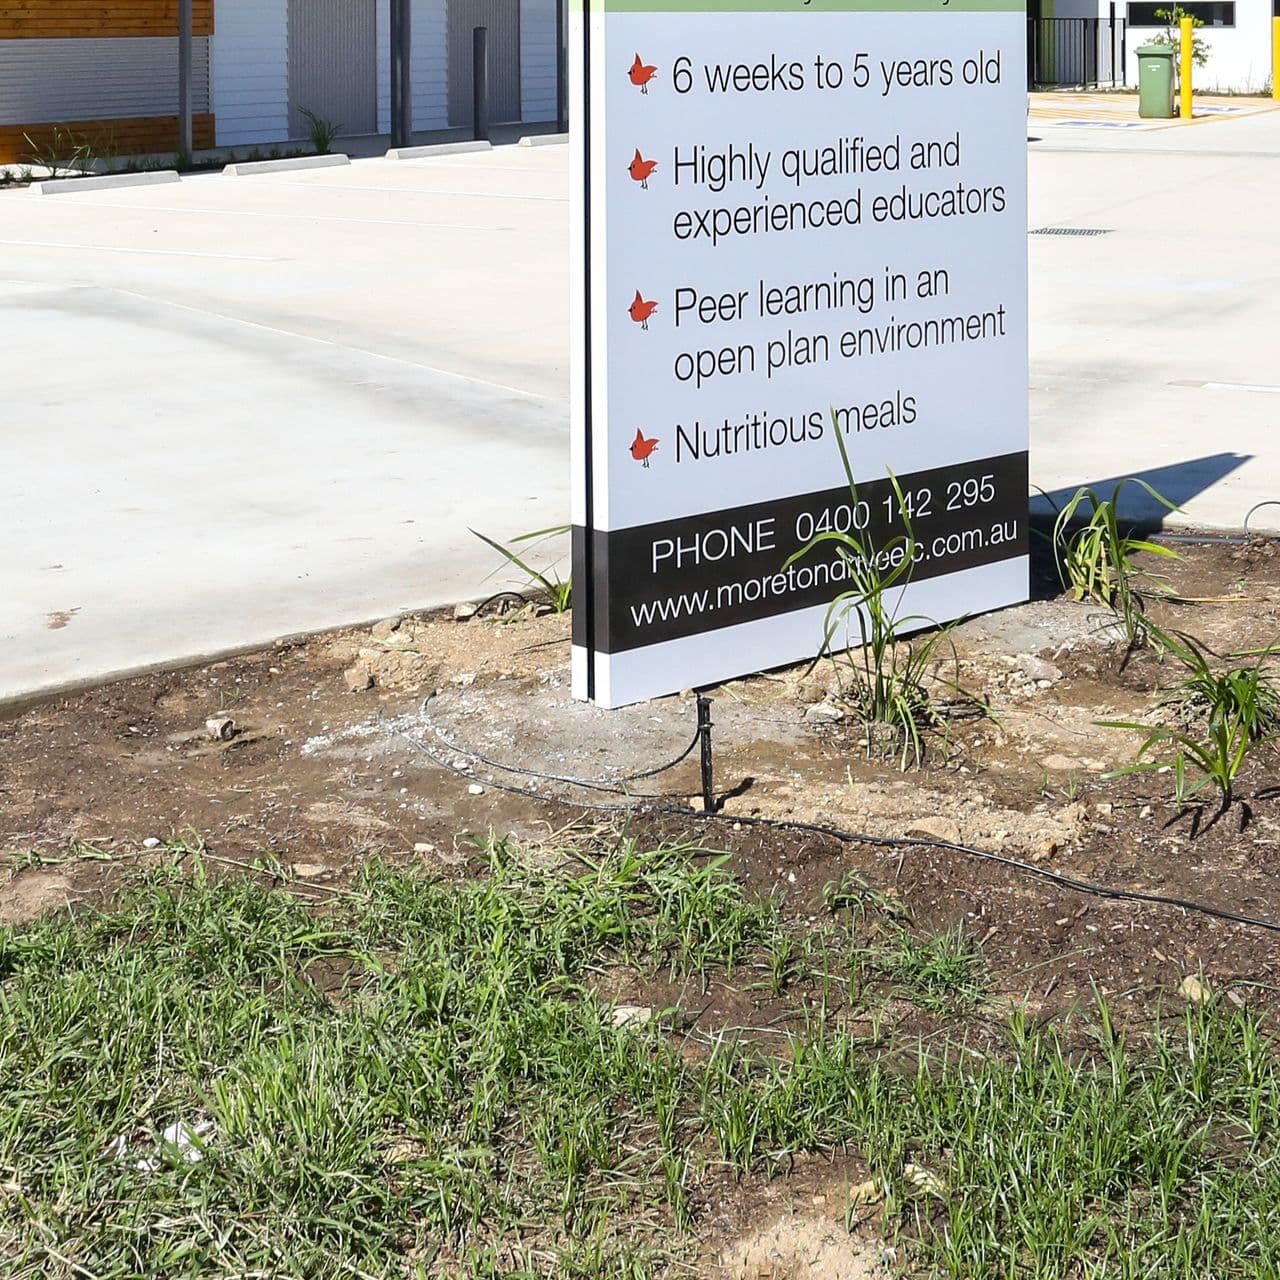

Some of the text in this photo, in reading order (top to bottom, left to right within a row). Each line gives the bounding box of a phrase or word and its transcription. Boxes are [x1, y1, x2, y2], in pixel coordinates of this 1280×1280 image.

[672, 49, 1002, 96] 6 weeks to 5 years old
[673, 131, 961, 192] Highly qualified and
[673, 183, 1007, 246] experienced educators
[674, 266, 950, 327] Peer learning in an
[673, 303, 1007, 389] open plan environment
[675, 389, 917, 463] Nutritious meals
[650, 474, 996, 574] PHONE 0400 142 295
